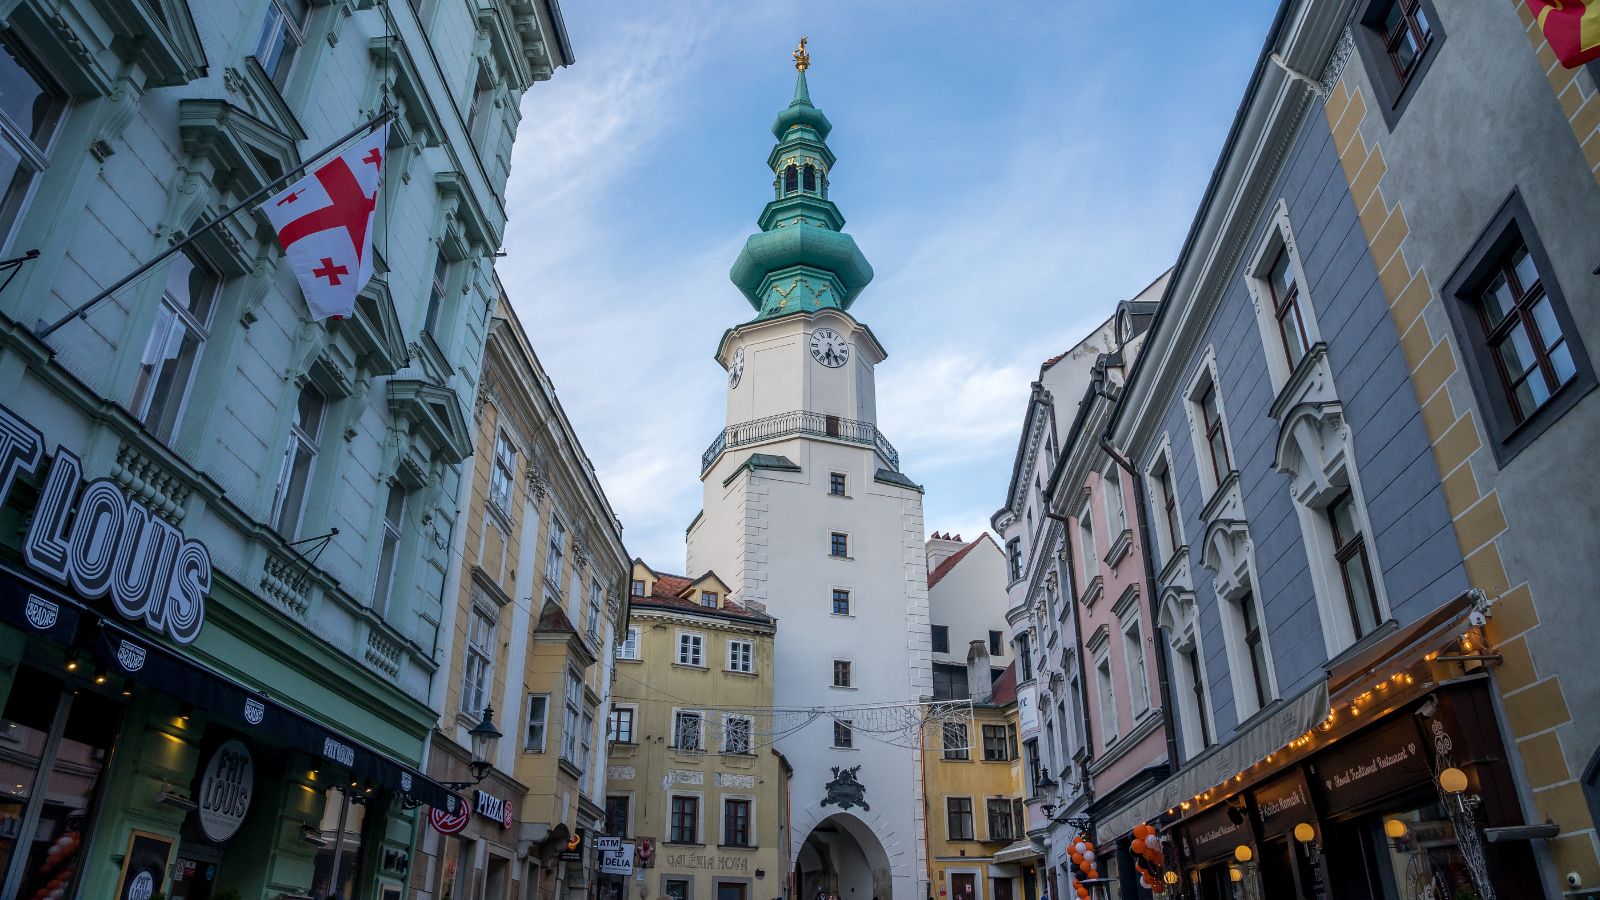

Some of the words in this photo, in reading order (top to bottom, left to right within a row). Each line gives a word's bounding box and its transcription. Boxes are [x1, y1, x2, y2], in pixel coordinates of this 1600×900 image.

[24, 446, 212, 645] LOUIS
[216, 747, 249, 785] FAT
[203, 776, 248, 818] LOUIS
[477, 789, 504, 823] PIZZA
[599, 839, 619, 848] ATM
[605, 857, 631, 868] DELIA
[718, 856, 748, 871] NOVA
